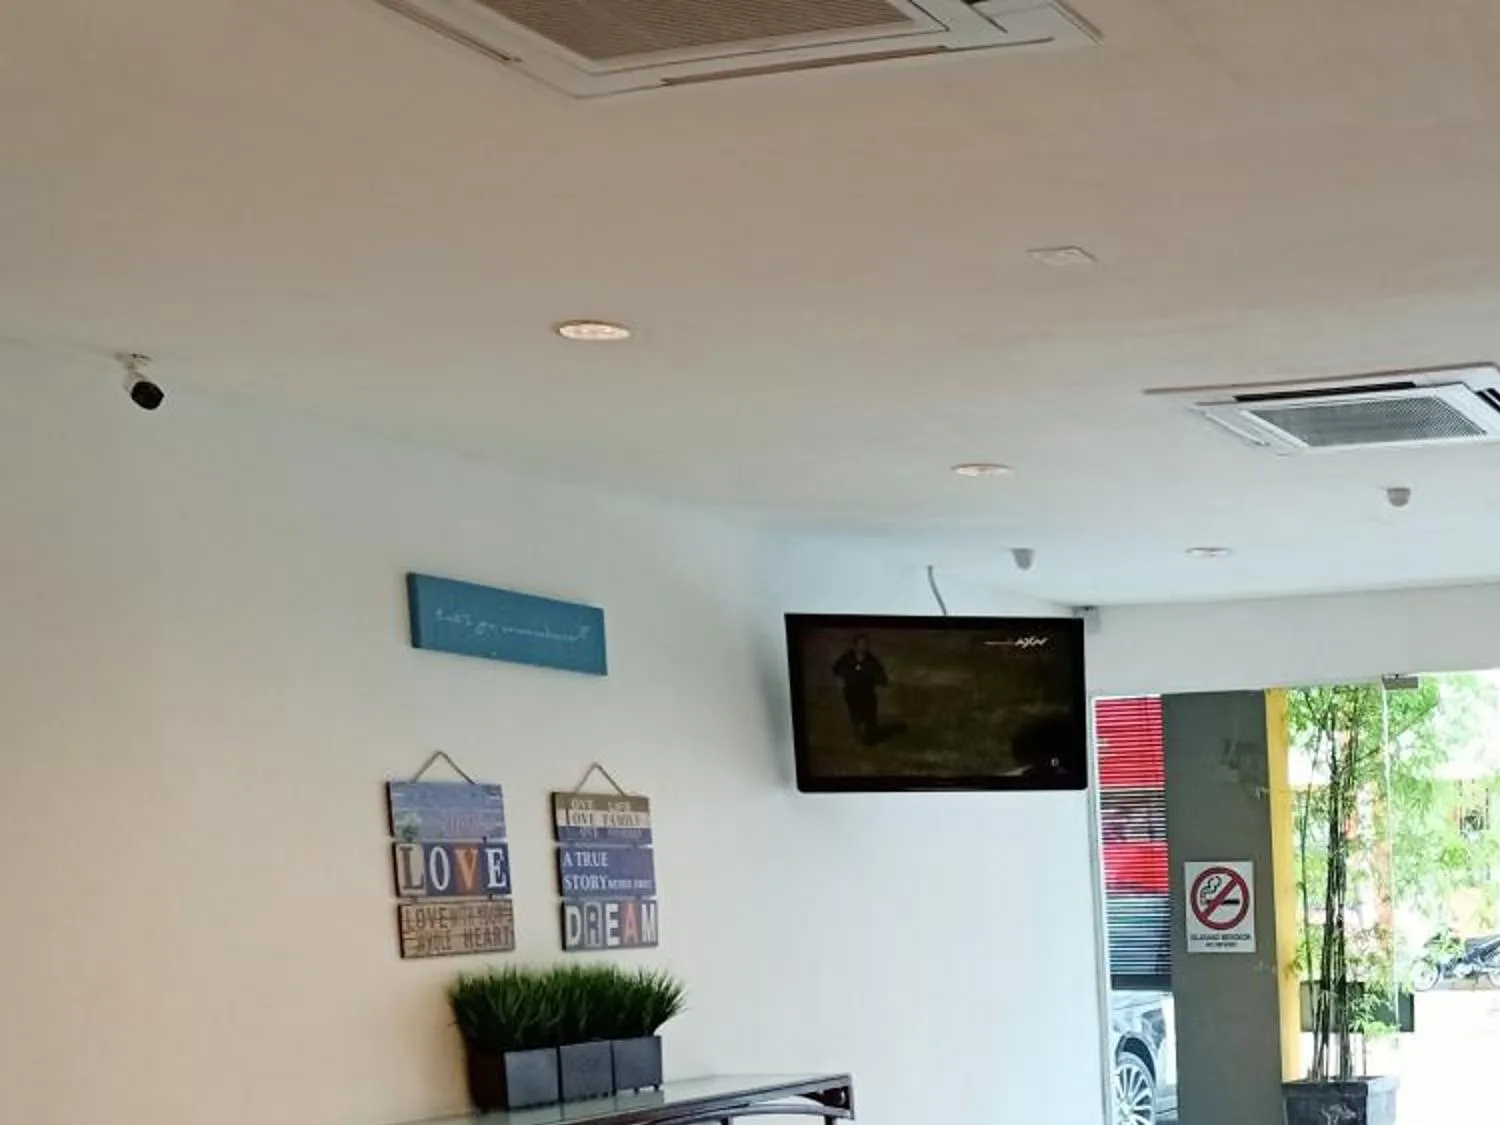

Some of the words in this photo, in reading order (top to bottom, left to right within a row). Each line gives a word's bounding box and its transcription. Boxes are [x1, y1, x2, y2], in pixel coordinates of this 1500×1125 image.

[400, 845, 508, 890] LOVE
[563, 854, 573, 867] A
[576, 852, 609, 868] TRUE
[563, 874, 608, 890] STORY
[403, 906, 448, 932] LOVE
[564, 902, 658, 947] DREAM
[463, 926, 511, 950] HEART
